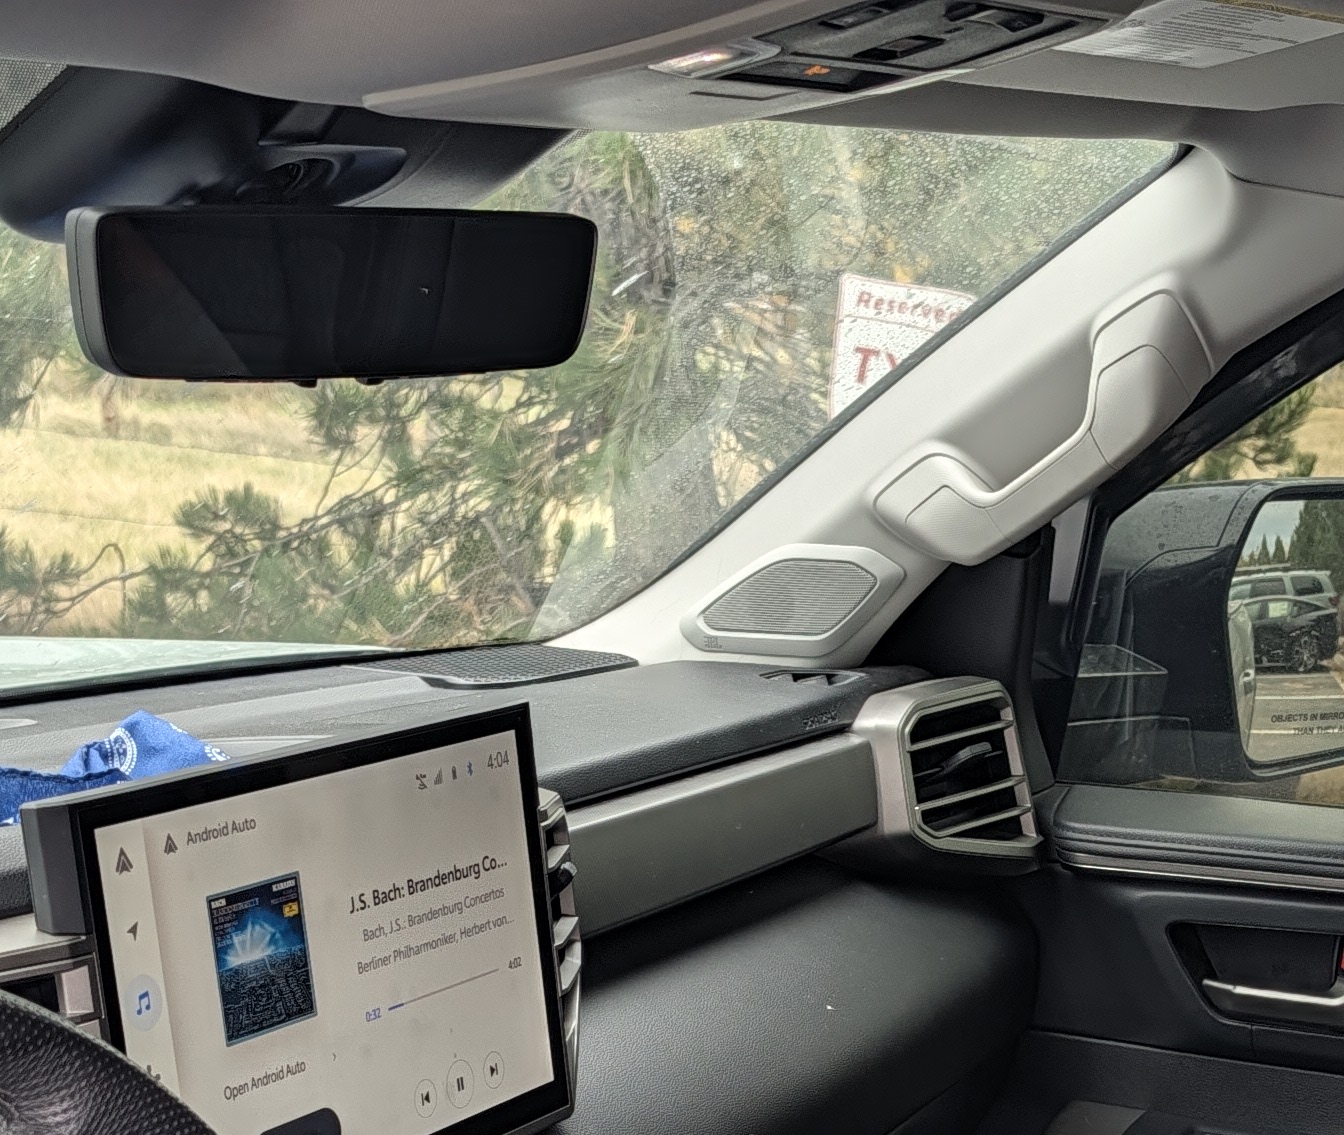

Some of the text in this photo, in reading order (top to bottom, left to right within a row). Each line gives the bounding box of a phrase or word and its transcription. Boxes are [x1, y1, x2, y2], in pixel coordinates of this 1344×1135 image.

[1271, 713, 1309, 723] OBJECTS
[1309, 712, 1318, 721] IN
[487, 749, 509, 770] 4:04
[186, 818, 257, 846] Android Auto
[349, 893, 371, 914] J.S.
[372, 882, 405, 907] Bach:
[406, 864, 481, 896] Brandenburg
[362, 926, 388, 943] Bach,
[407, 900, 463, 929] Brandenburg
[463, 887, 506, 909] Concertos
[357, 955, 392, 975] Berliner
[392, 932, 459, 963] Philharmoniker,
[459, 919, 492, 939] Herbert
[508, 956, 523, 970] 4:02
[365, 1007, 382, 1023] 0:32
[223, 1061, 307, 1101] Open Android Auto
